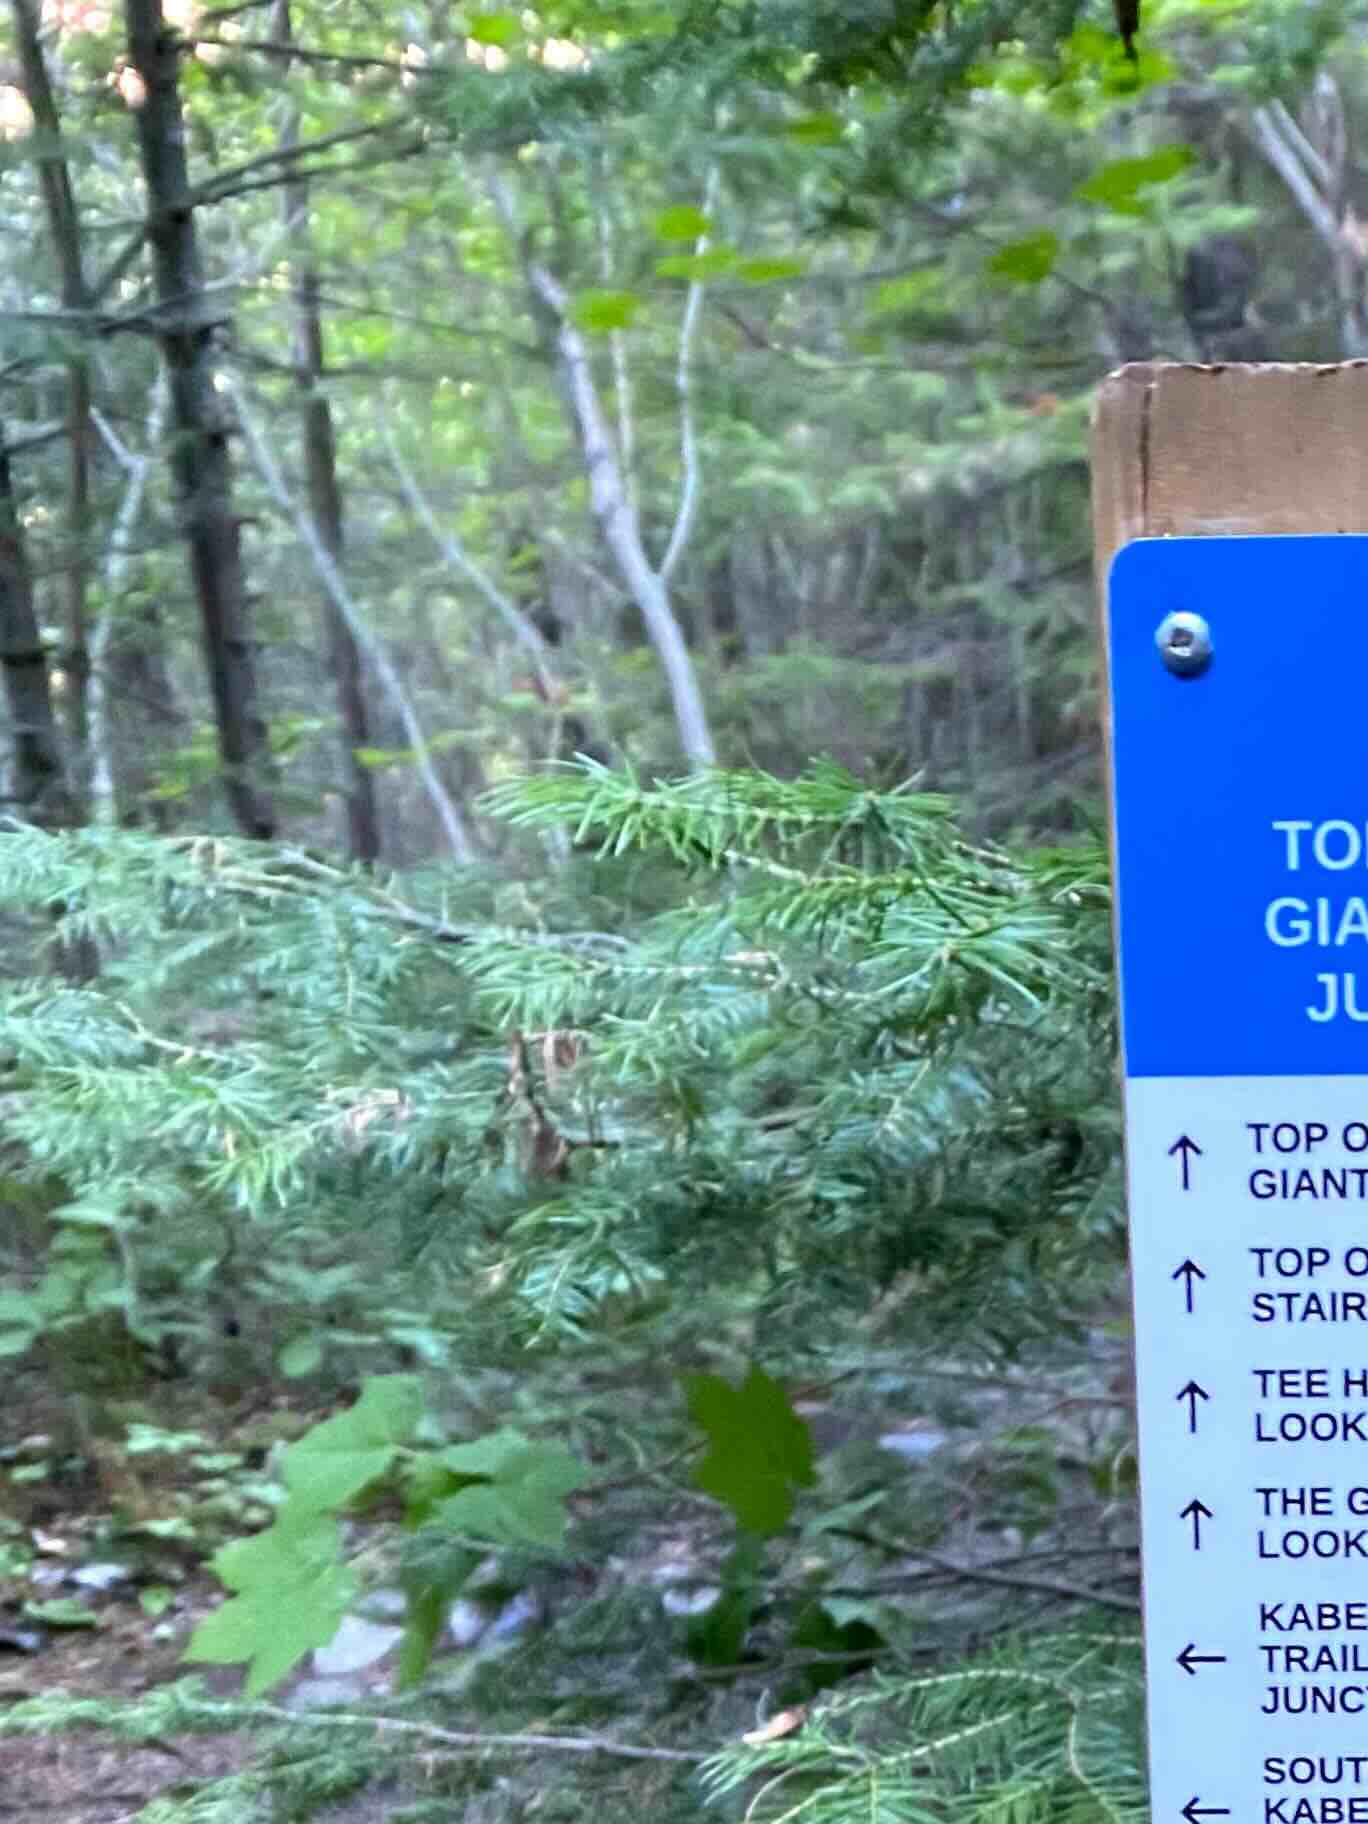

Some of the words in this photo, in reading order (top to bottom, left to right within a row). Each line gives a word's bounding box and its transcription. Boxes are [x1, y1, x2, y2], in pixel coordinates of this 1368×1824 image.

[1247, 1122, 1328, 1153] TOP
[1250, 1247, 1330, 1277] TOP
[1252, 1369, 1329, 1398] TEE
[1256, 1488, 1333, 1516] THE
